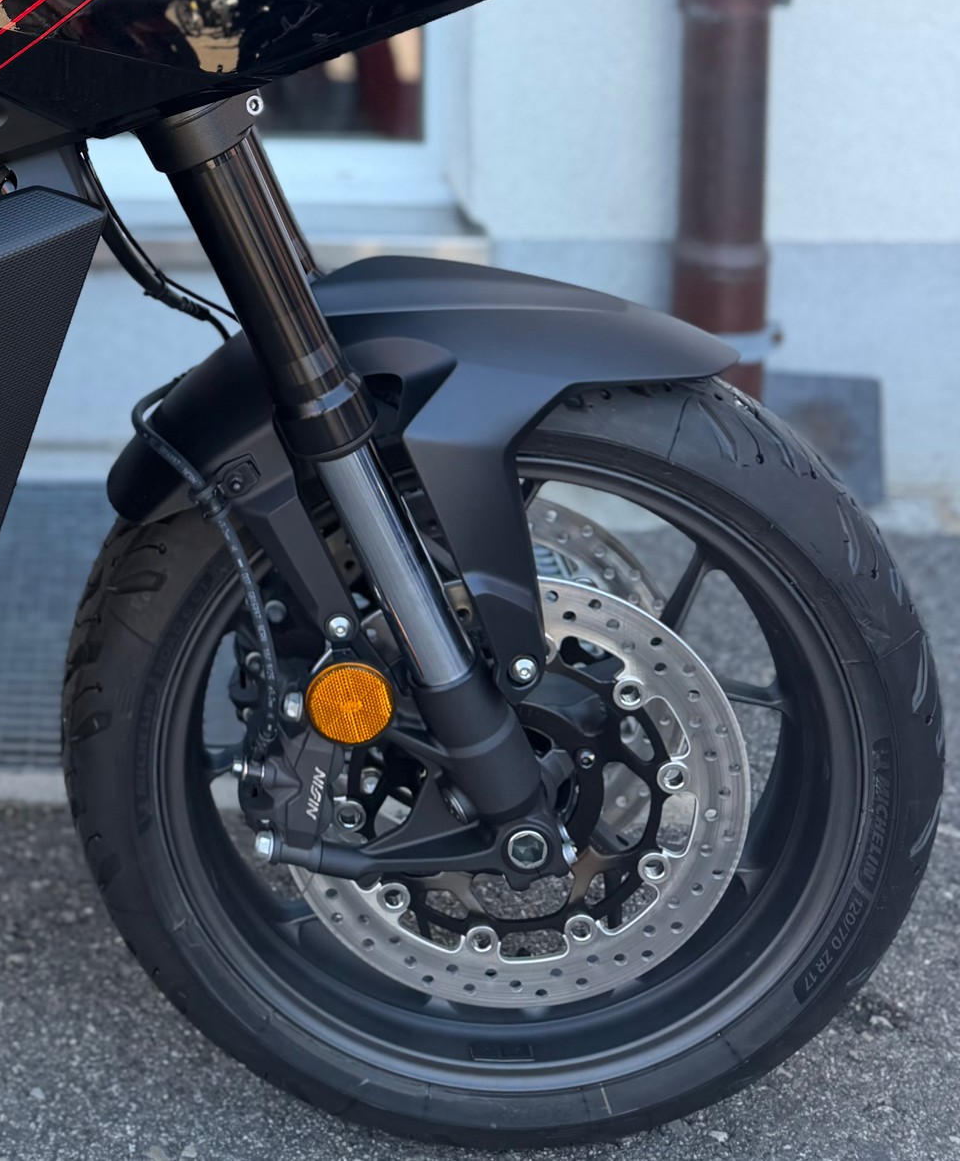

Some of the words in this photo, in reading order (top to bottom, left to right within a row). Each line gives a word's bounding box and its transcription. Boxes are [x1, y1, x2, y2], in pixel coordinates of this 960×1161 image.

[863, 774, 891, 882] MICHELIN
[831, 896, 864, 951] 120/70
[803, 970, 819, 992] 17
[815, 953, 834, 974] ZR
